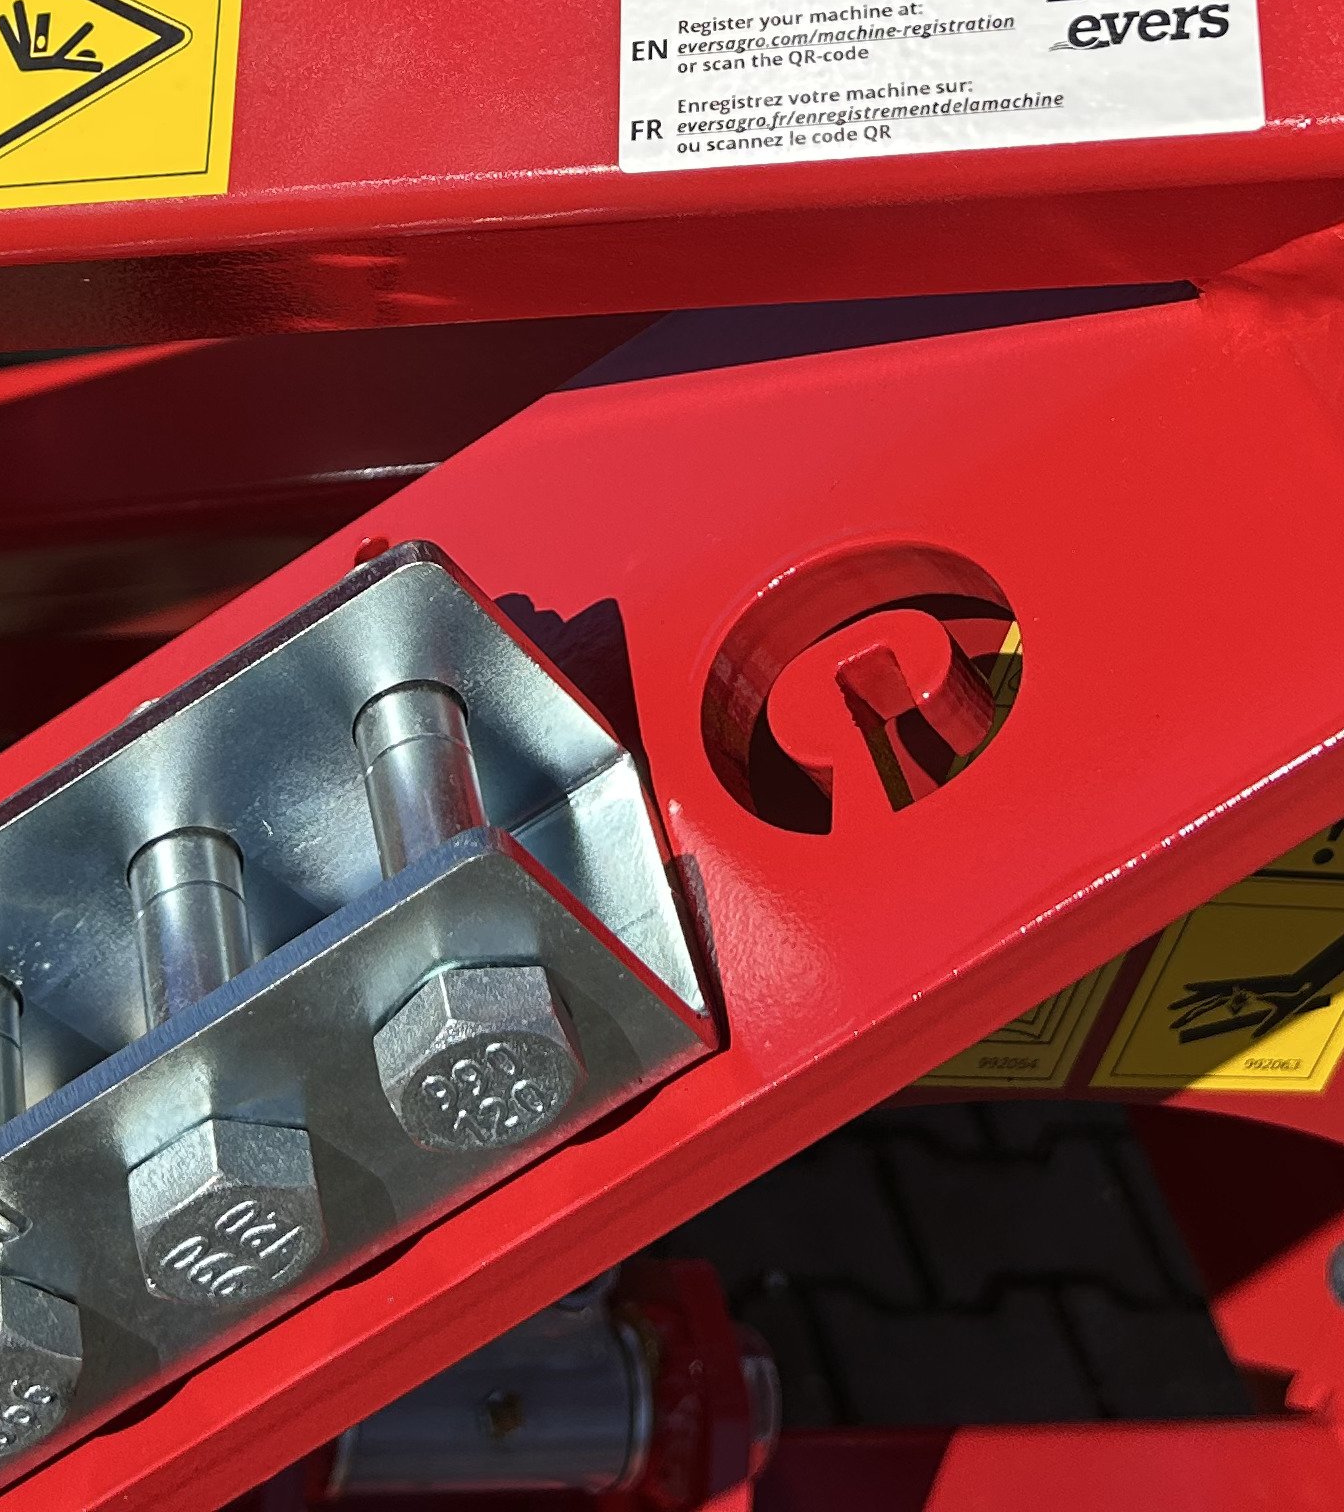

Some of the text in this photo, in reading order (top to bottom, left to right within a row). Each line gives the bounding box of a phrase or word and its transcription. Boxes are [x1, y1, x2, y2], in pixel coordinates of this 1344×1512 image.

[676, 16, 1016, 56] eversagro.com/machine-registration
[677, 1, 923, 37] Register your machine at:
[1066, 3, 1231, 49] evers
[630, 37, 668, 62] EN
[676, 45, 870, 74] or scan the QR-code
[675, 92, 1064, 136] eversagro.fr/enregistrementdelamachine
[676, 79, 973, 115] Enregistrez votre machine sur:
[629, 117, 664, 142] FR
[675, 123, 892, 154] ou scannez le code QR
